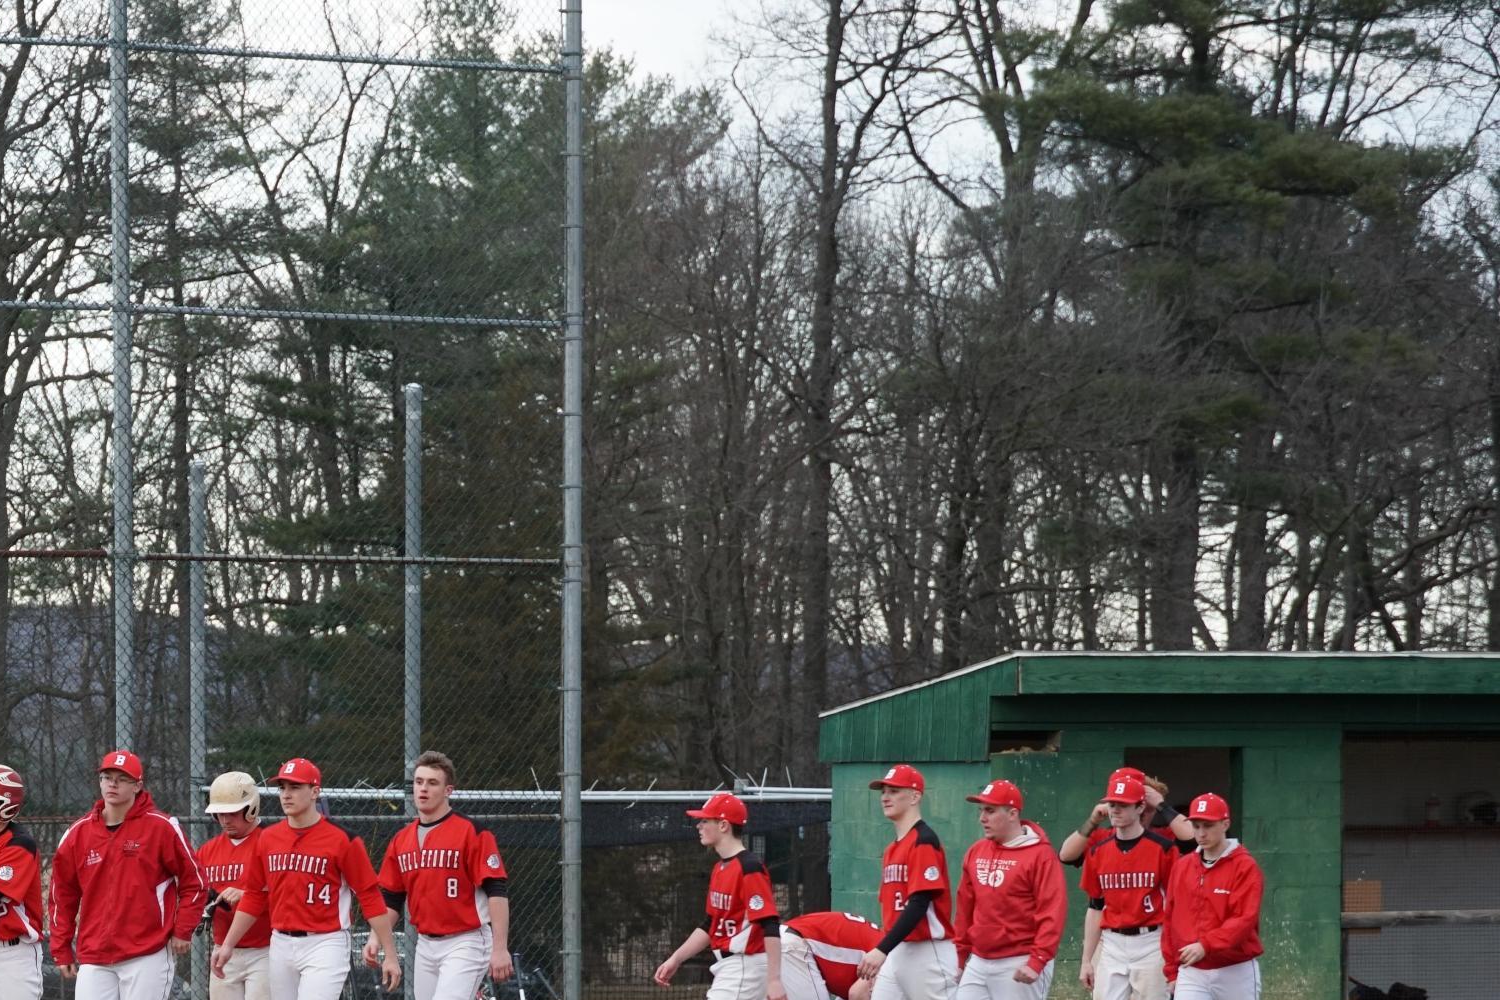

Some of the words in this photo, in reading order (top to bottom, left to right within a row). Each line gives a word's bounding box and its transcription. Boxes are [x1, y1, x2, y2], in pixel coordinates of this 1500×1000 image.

[114, 754, 126, 766] B
[284, 762, 296, 774] B
[1114, 782, 1126, 794] B
[1196, 800, 1208, 812] B
[306, 882, 332, 905] 14
[446, 878, 458, 898] 8
[894, 891, 910, 911] 2
[1143, 893, 1155, 914] 9
